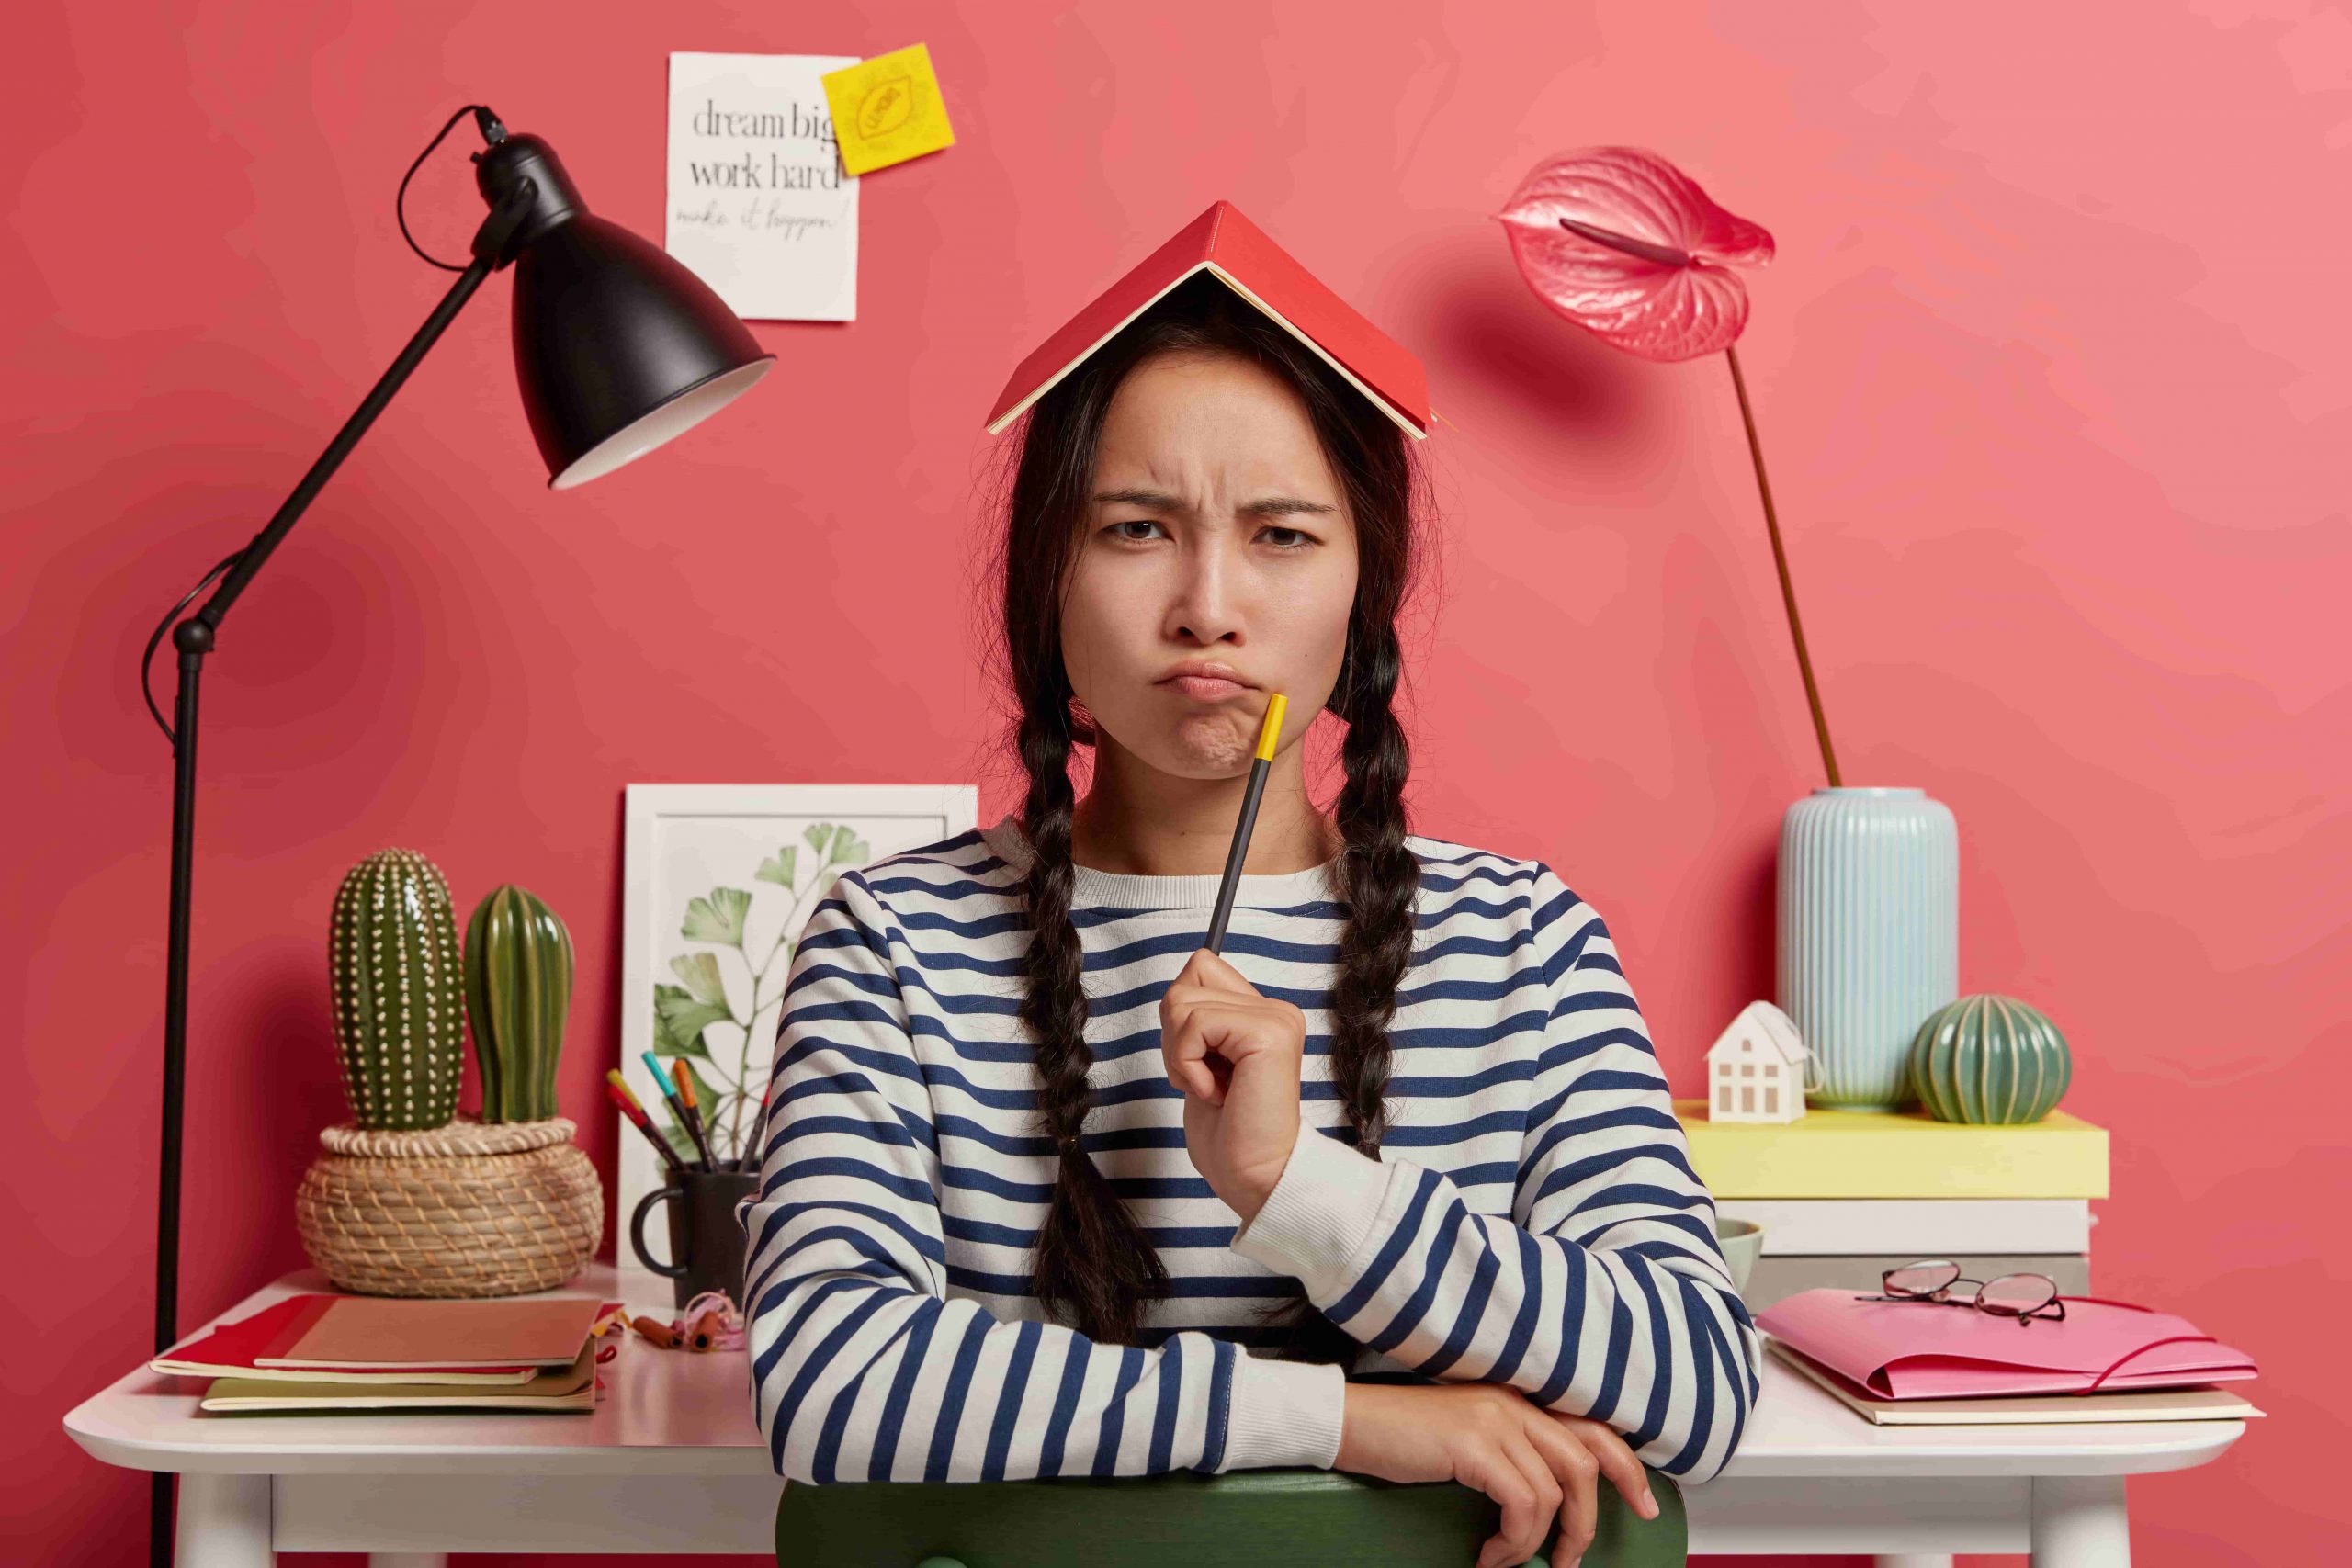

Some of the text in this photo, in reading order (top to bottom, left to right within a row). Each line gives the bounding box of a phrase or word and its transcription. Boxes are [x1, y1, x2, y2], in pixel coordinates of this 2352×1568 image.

[693, 99, 785, 138] dream
[690, 152, 841, 190] work hard
[740, 196, 762, 231] it
